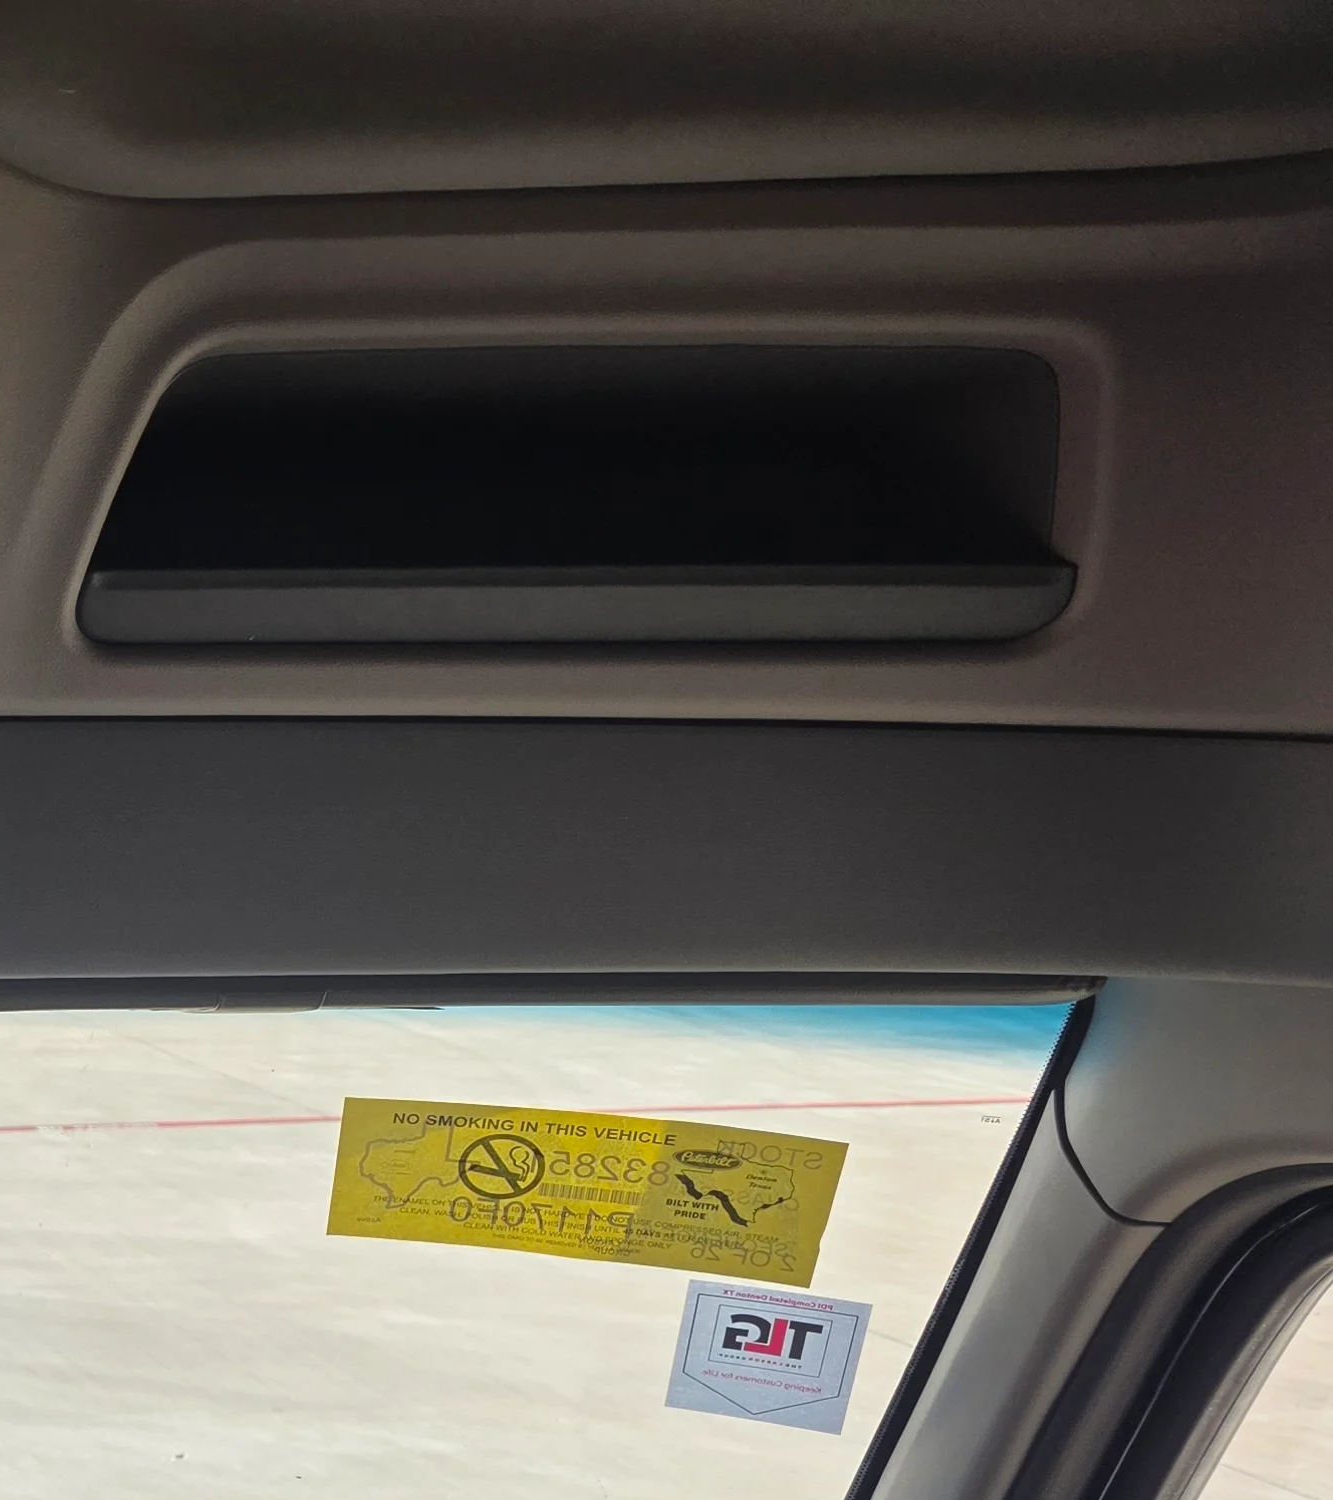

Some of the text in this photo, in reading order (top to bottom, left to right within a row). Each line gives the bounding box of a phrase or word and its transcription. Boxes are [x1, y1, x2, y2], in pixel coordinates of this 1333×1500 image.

[393, 1112, 677, 1147] NO SMOKING IN THIS VEHICLE
[681, 1151, 735, 1168] Peterbilt
[745, 1174, 778, 1184] Denton
[666, 1198, 720, 1211] BILT WITH
[394, 1197, 430, 1206] ENAMEL
[634, 1217, 651, 1226] USE
[654, 1220, 721, 1236] COMPRESSED
[745, 1233, 779, 1243] STEAM
[673, 1209, 706, 1220] PRIDE
[464, 1222, 494, 1231] CLEAN
[496, 1224, 520, 1233] WITH
[522, 1227, 548, 1236] COLD
[549, 1231, 581, 1240] WATER
[647, 1240, 673, 1249] ONLY
[594, 1225, 620, 1234] UNTIL
[635, 1228, 661, 1238] DAYS
